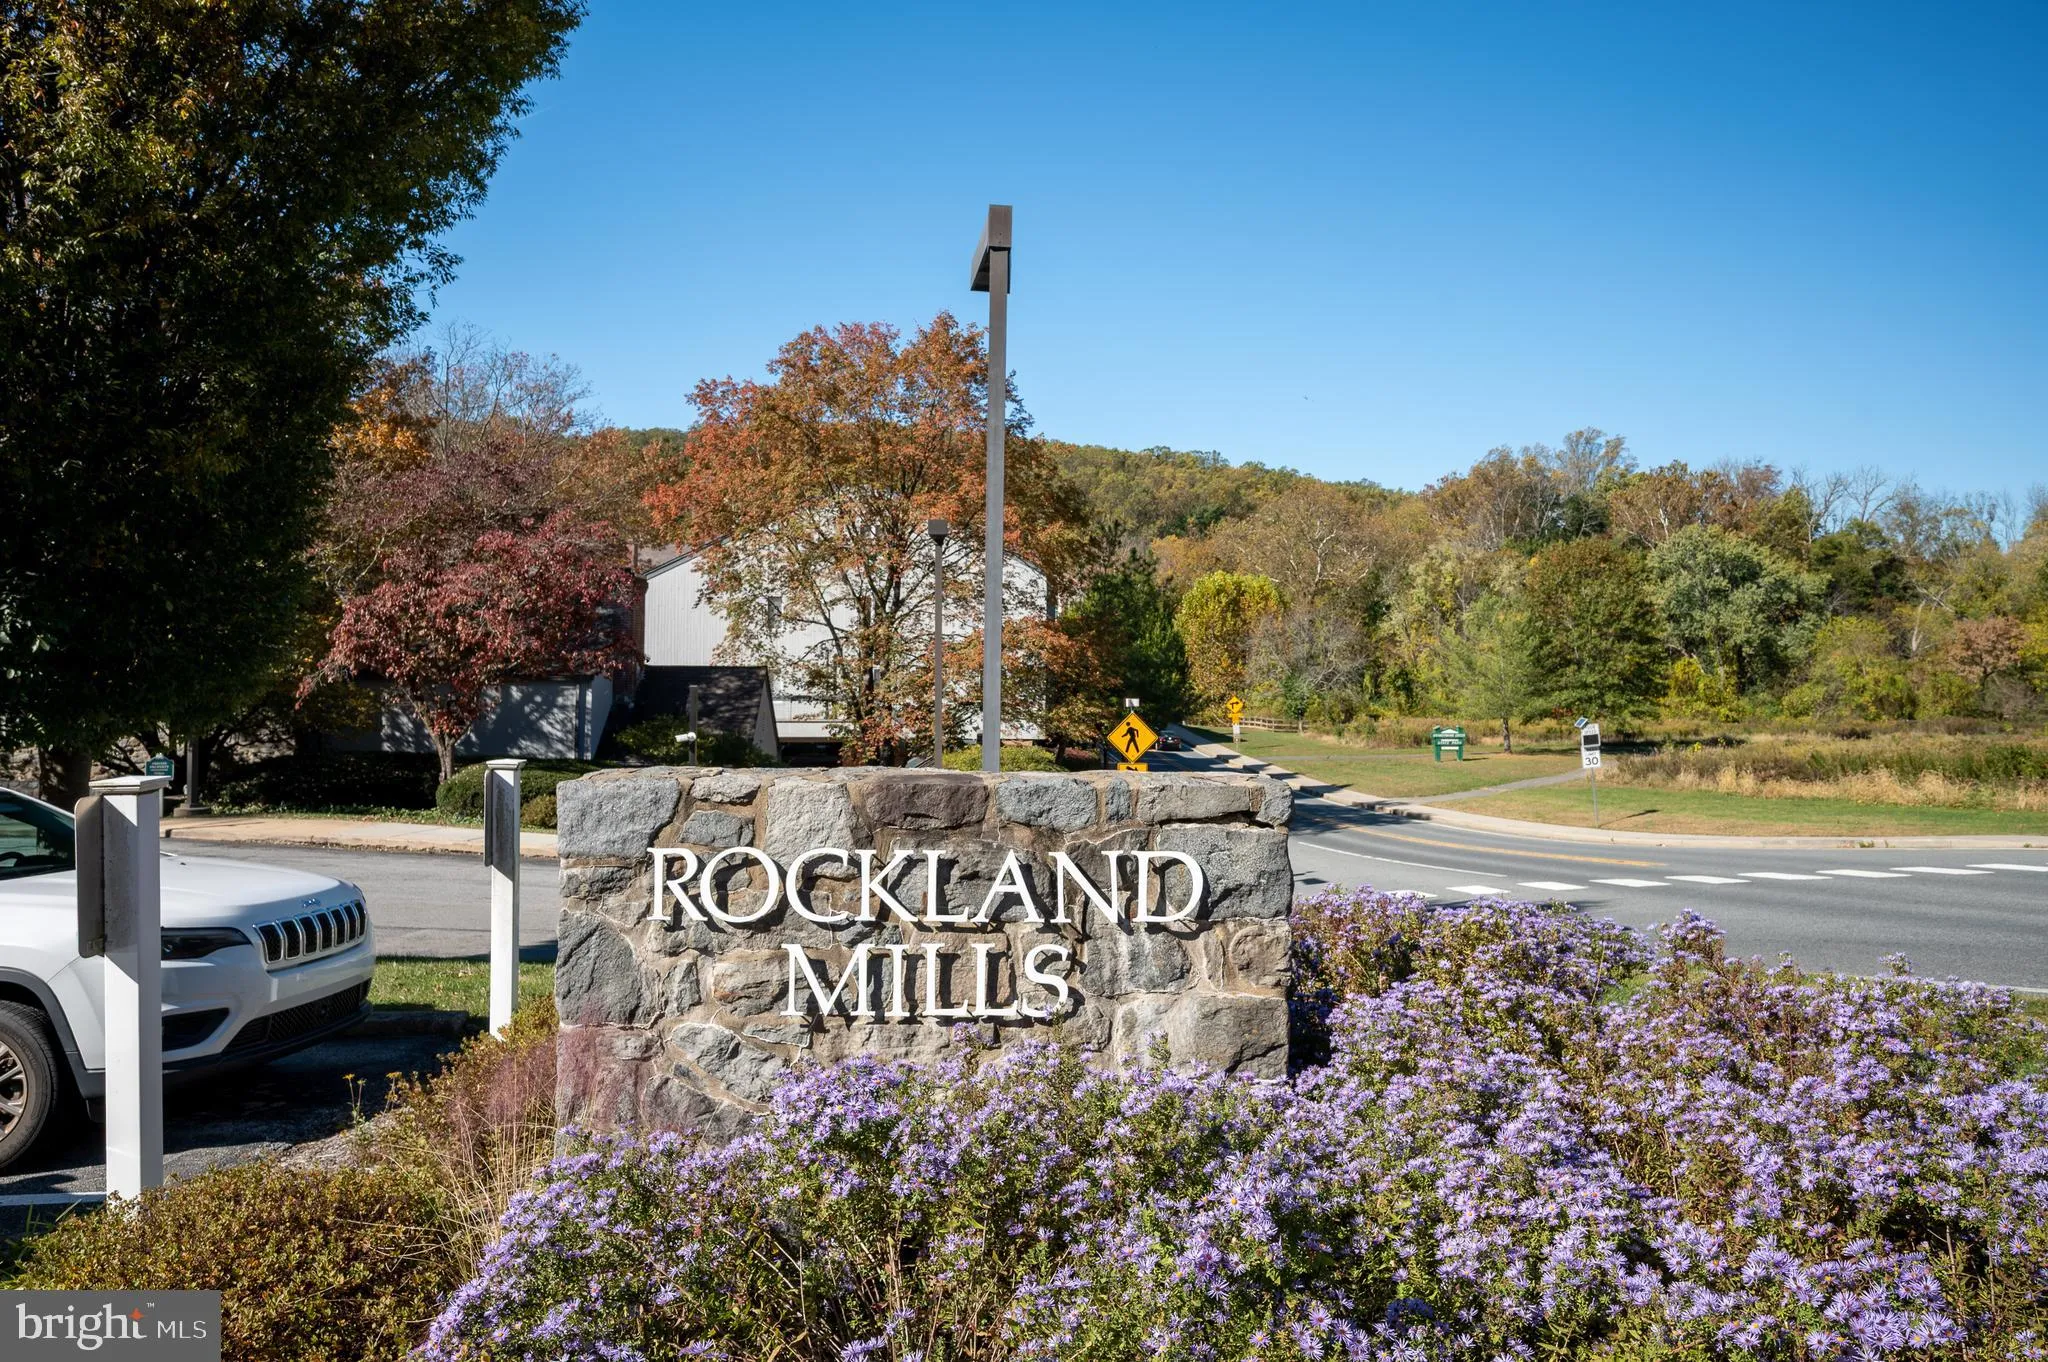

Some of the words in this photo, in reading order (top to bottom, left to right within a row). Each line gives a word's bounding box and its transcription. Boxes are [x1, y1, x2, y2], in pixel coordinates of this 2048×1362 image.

[1585, 756, 1599, 766] 30
[646, 846, 1205, 924] ROCKLAND
[780, 942, 1074, 1020] MILLS
